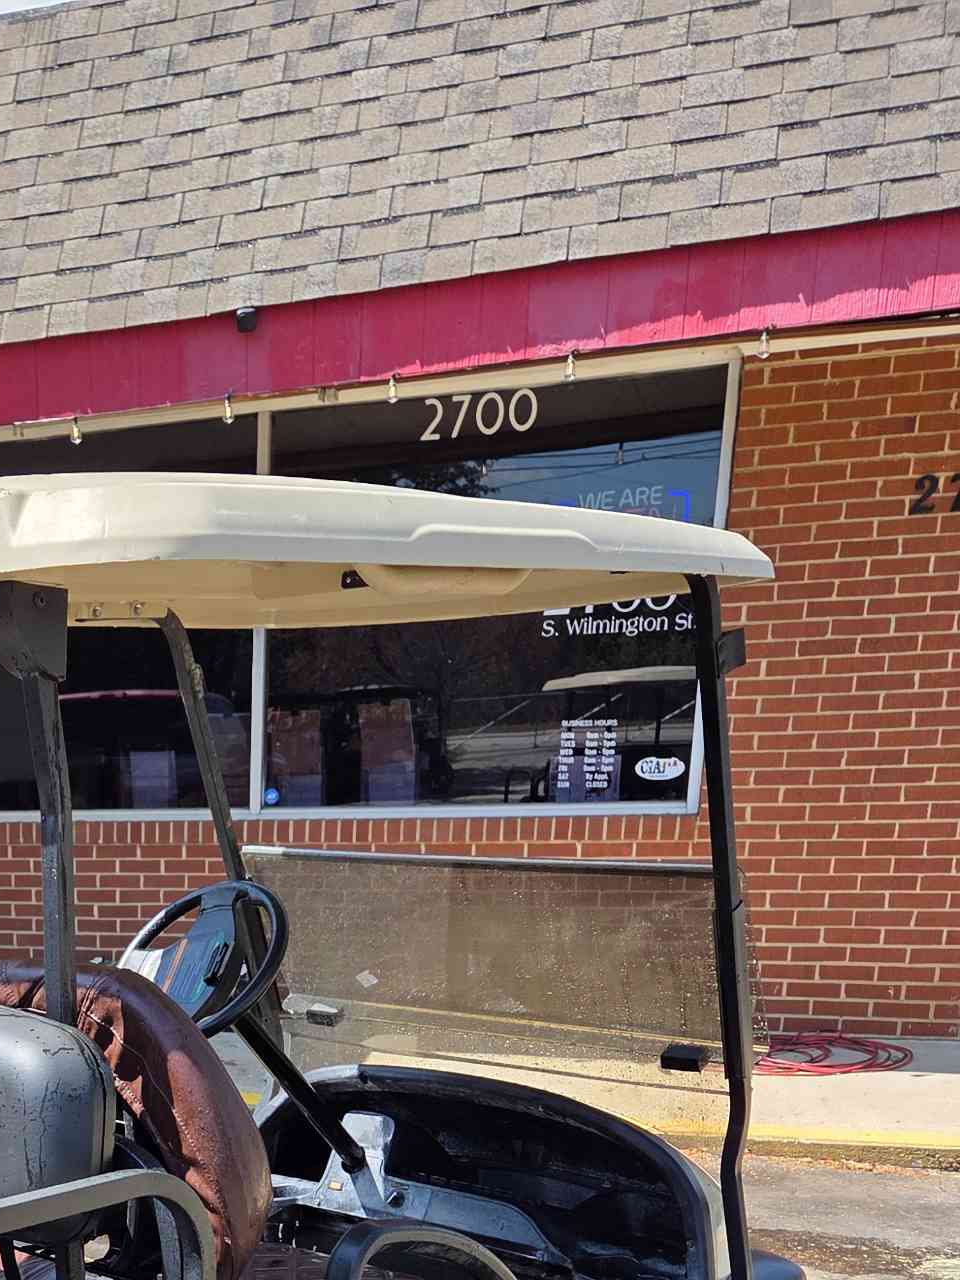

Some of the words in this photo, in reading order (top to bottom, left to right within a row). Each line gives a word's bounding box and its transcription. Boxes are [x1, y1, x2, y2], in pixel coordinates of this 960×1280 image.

[420, 388, 538, 441] 2700
[578, 490, 616, 509] WE
[619, 485, 664, 507] ARE
[541, 620, 559, 637] S.
[566, 615, 668, 636] Wilmington
[675, 613, 697, 631] St.
